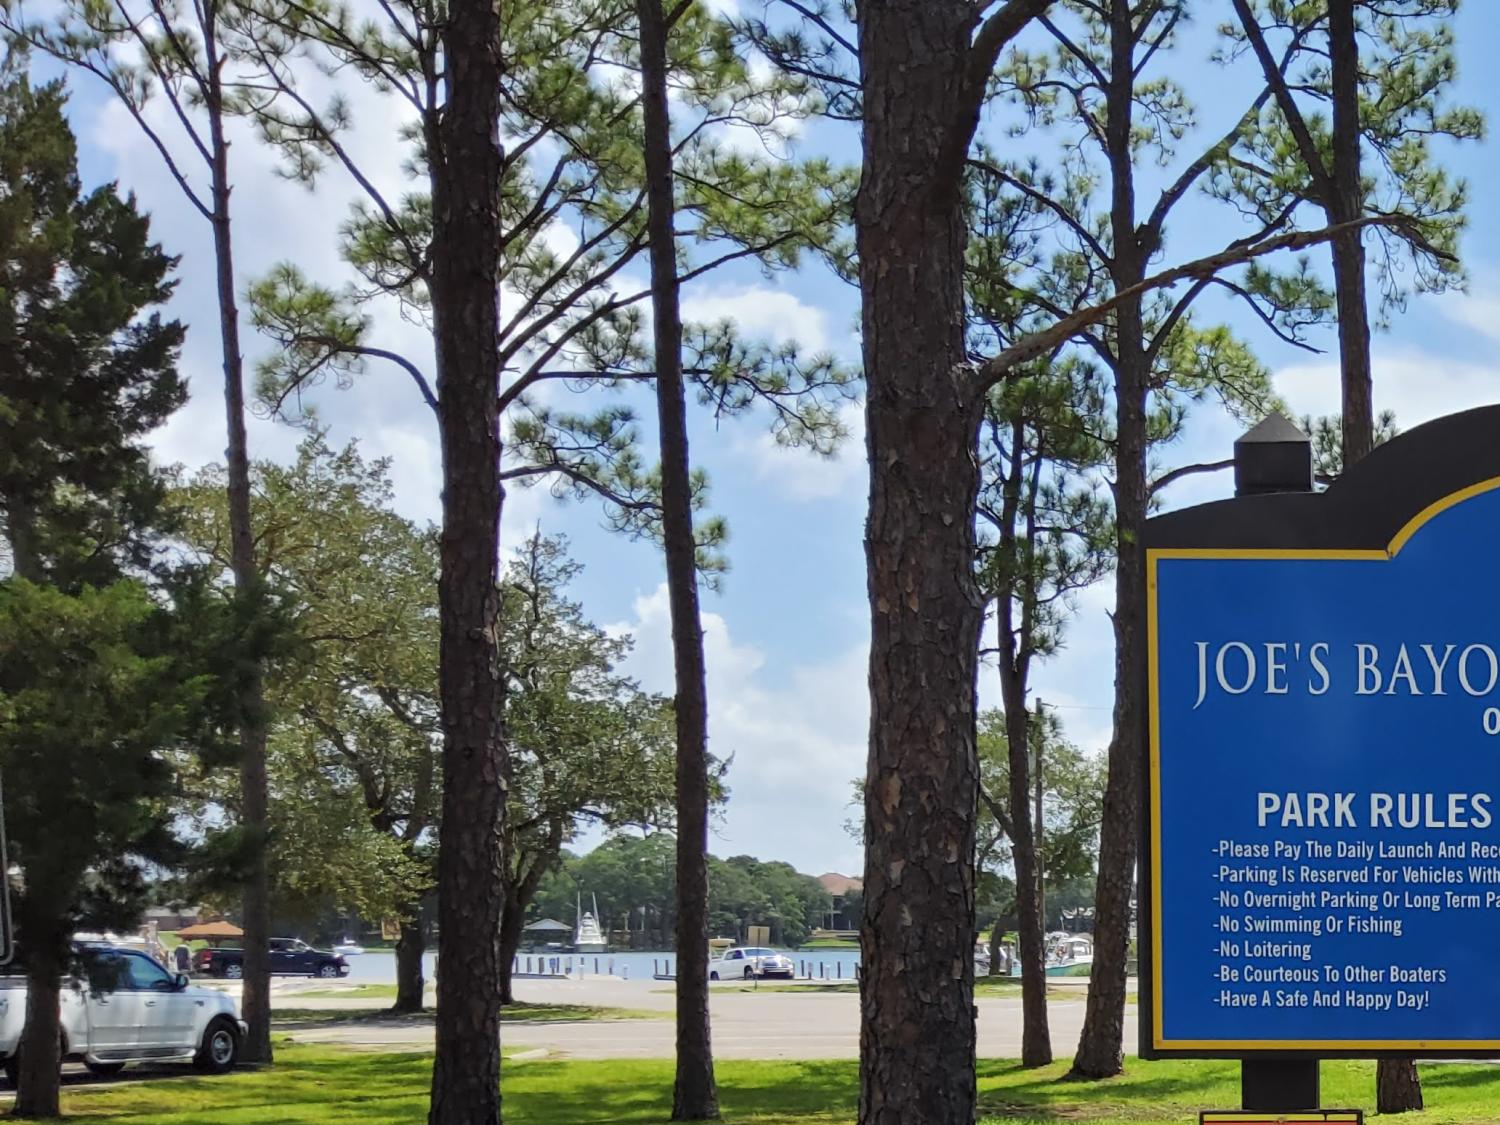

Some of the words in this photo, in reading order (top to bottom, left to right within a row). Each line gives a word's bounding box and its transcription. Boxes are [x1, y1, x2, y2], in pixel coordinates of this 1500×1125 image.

[1193, 641, 1330, 710] JOE'S
[1258, 792, 1357, 827] PARK
[1370, 793, 1491, 828] RULES
[1212, 840, 1269, 857] -Please
[1275, 840, 1301, 861] Pay
[1305, 840, 1332, 858] The
[1337, 841, 1374, 861] Daily
[1379, 841, 1433, 858] Launch
[1438, 841, 1465, 858] And
[1213, 865, 1278, 886] -Parking
[1282, 866, 1295, 882] Is
[1300, 866, 1368, 883] Reserved
[1374, 866, 1398, 883] For
[1402, 866, 1463, 883] Vehicles
[1468, 866, 1500, 883] With
[1213, 891, 1239, 907] -No
[1244, 890, 1316, 911] Overnight
[1321, 891, 1378, 911] Parking
[1383, 891, 1400, 908] Or
[1405, 891, 1440, 911] Long
[1445, 891, 1480, 908] Term
[1213, 915, 1239, 932] -No
[1244, 915, 1322, 936] Swimming
[1326, 916, 1343, 932] Or
[1348, 916, 1402, 936] Fishing
[1213, 940, 1239, 957] -No
[1245, 940, 1311, 961] Loitering
[1214, 965, 1239, 982] -Be
[1244, 965, 1319, 982] Courteous
[1324, 965, 1339, 982] To
[1345, 965, 1385, 982] Other
[1390, 965, 1446, 982] Boaters
[1214, 990, 1257, 1006] -Have
[1262, 990, 1271, 1006] A
[1276, 990, 1308, 1007] Safe
[1313, 990, 1340, 1007] And
[1346, 990, 1392, 1010] Happy
[1397, 991, 1428, 1010] Day!
